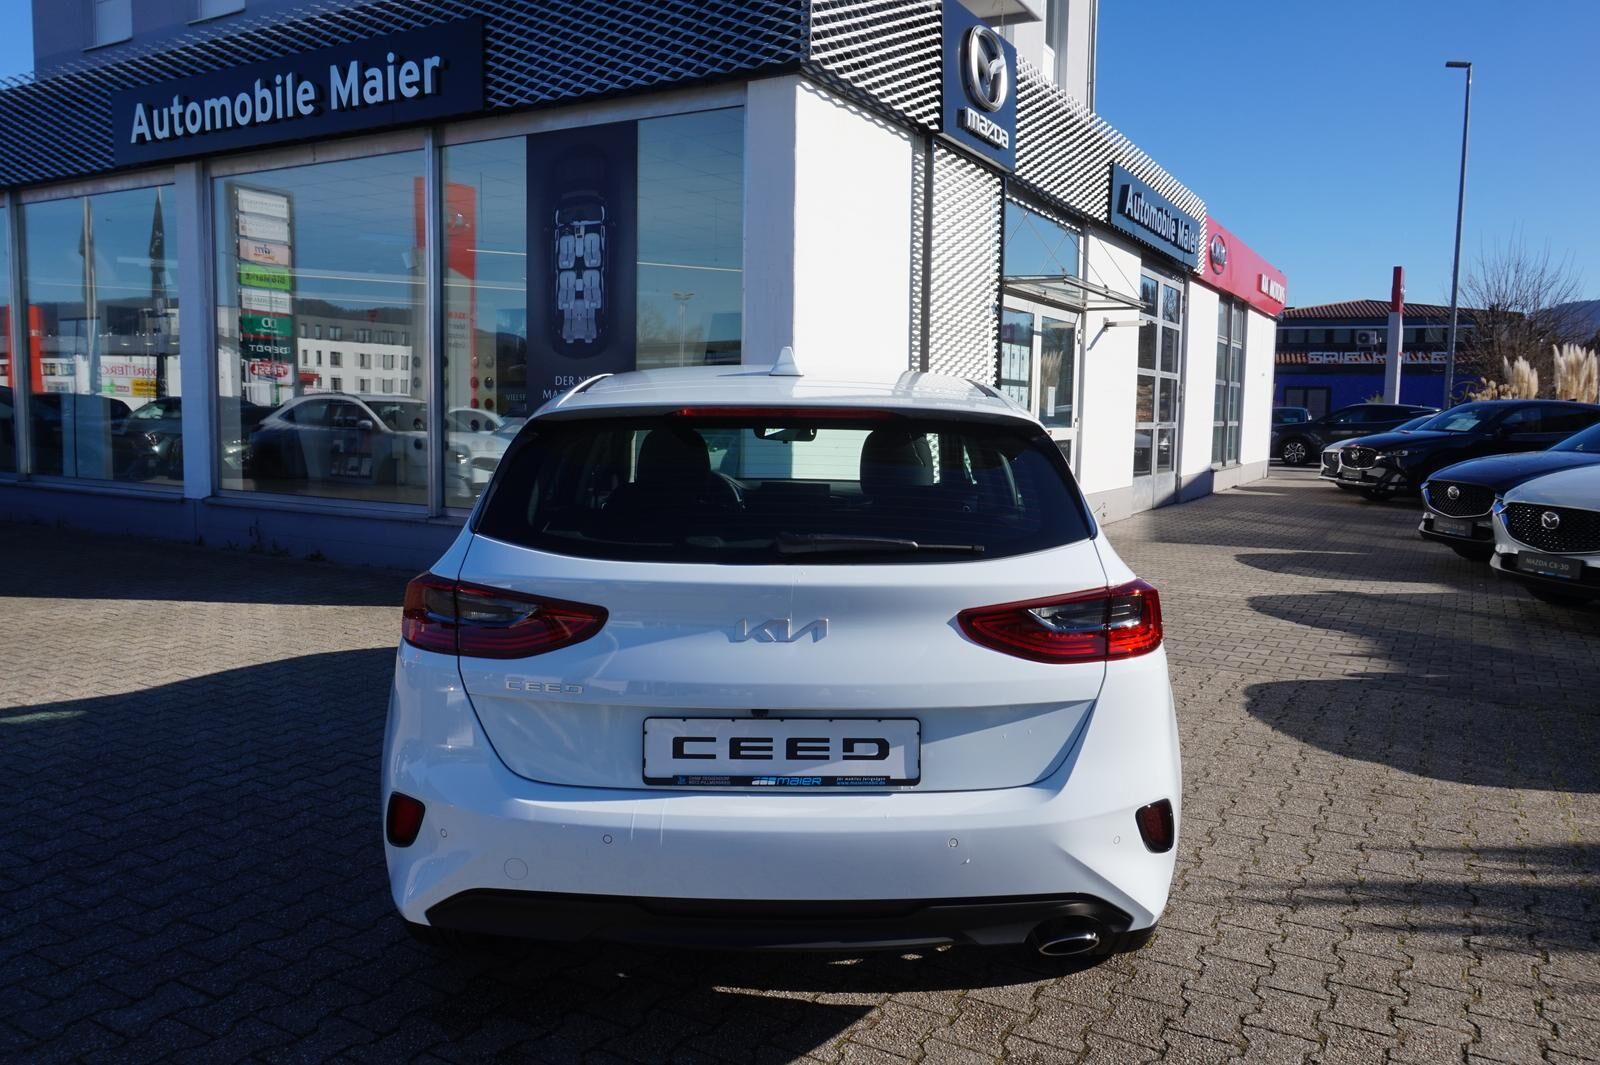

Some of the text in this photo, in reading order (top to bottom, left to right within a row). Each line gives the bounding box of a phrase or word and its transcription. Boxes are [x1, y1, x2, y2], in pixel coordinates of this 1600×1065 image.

[130, 52, 441, 144] Automobile Maier
[1125, 184, 1199, 254] Automobile Maier
[1308, 351, 1448, 364] SPIELHLLE
[555, 375, 575, 386] DER
[1526, 557, 1547, 568] MAZDA
[672, 736, 891, 761] CEED
